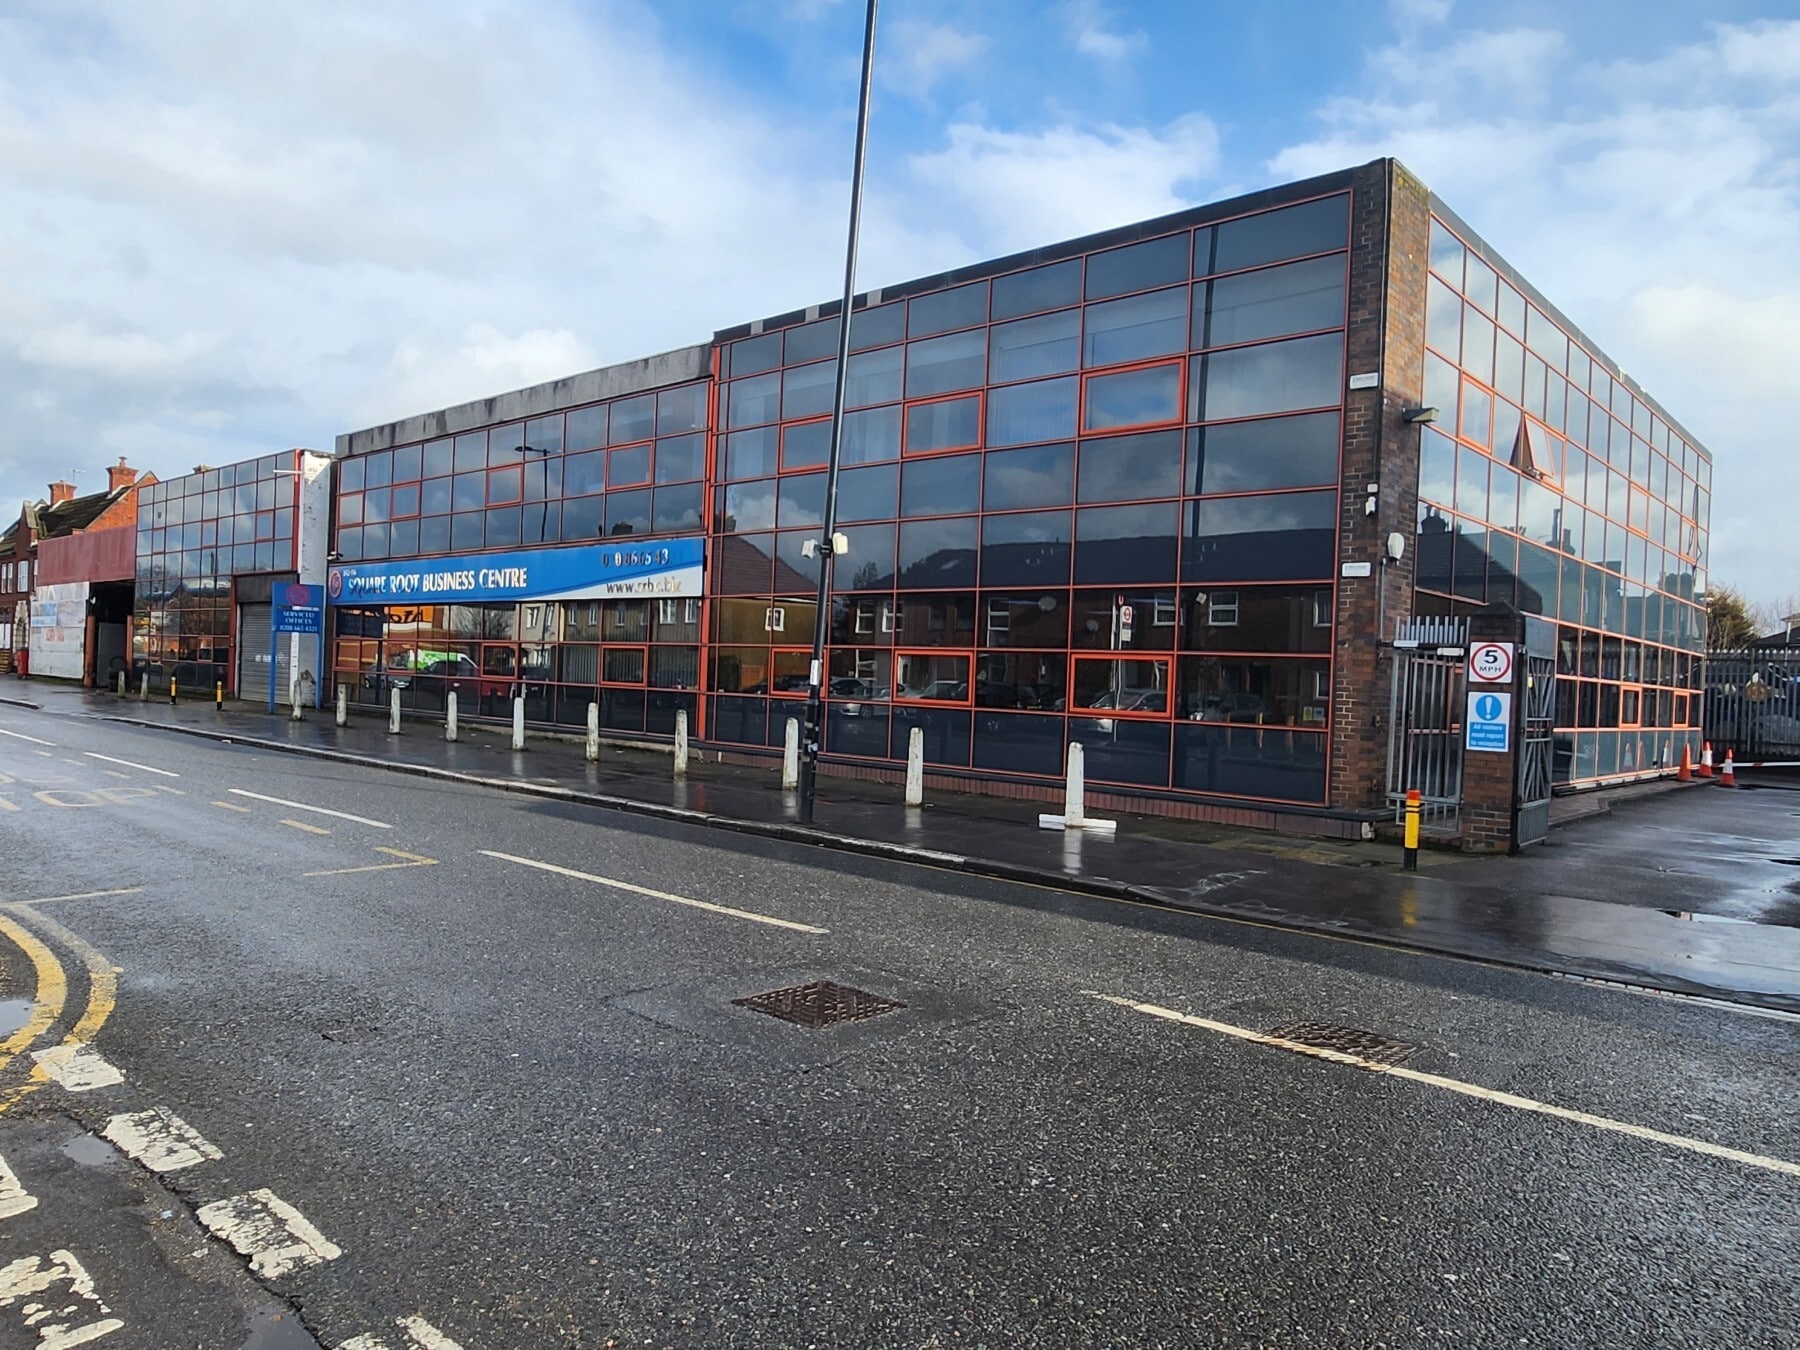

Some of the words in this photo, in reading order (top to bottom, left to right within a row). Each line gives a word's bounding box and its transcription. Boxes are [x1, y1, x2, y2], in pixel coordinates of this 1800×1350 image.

[348, 576, 387, 596] SQUARE
[390, 574, 420, 593] ROOT
[423, 570, 475, 592] BUSINESS
[479, 567, 527, 589] CENTRE
[1484, 650, 1498, 664] 5
